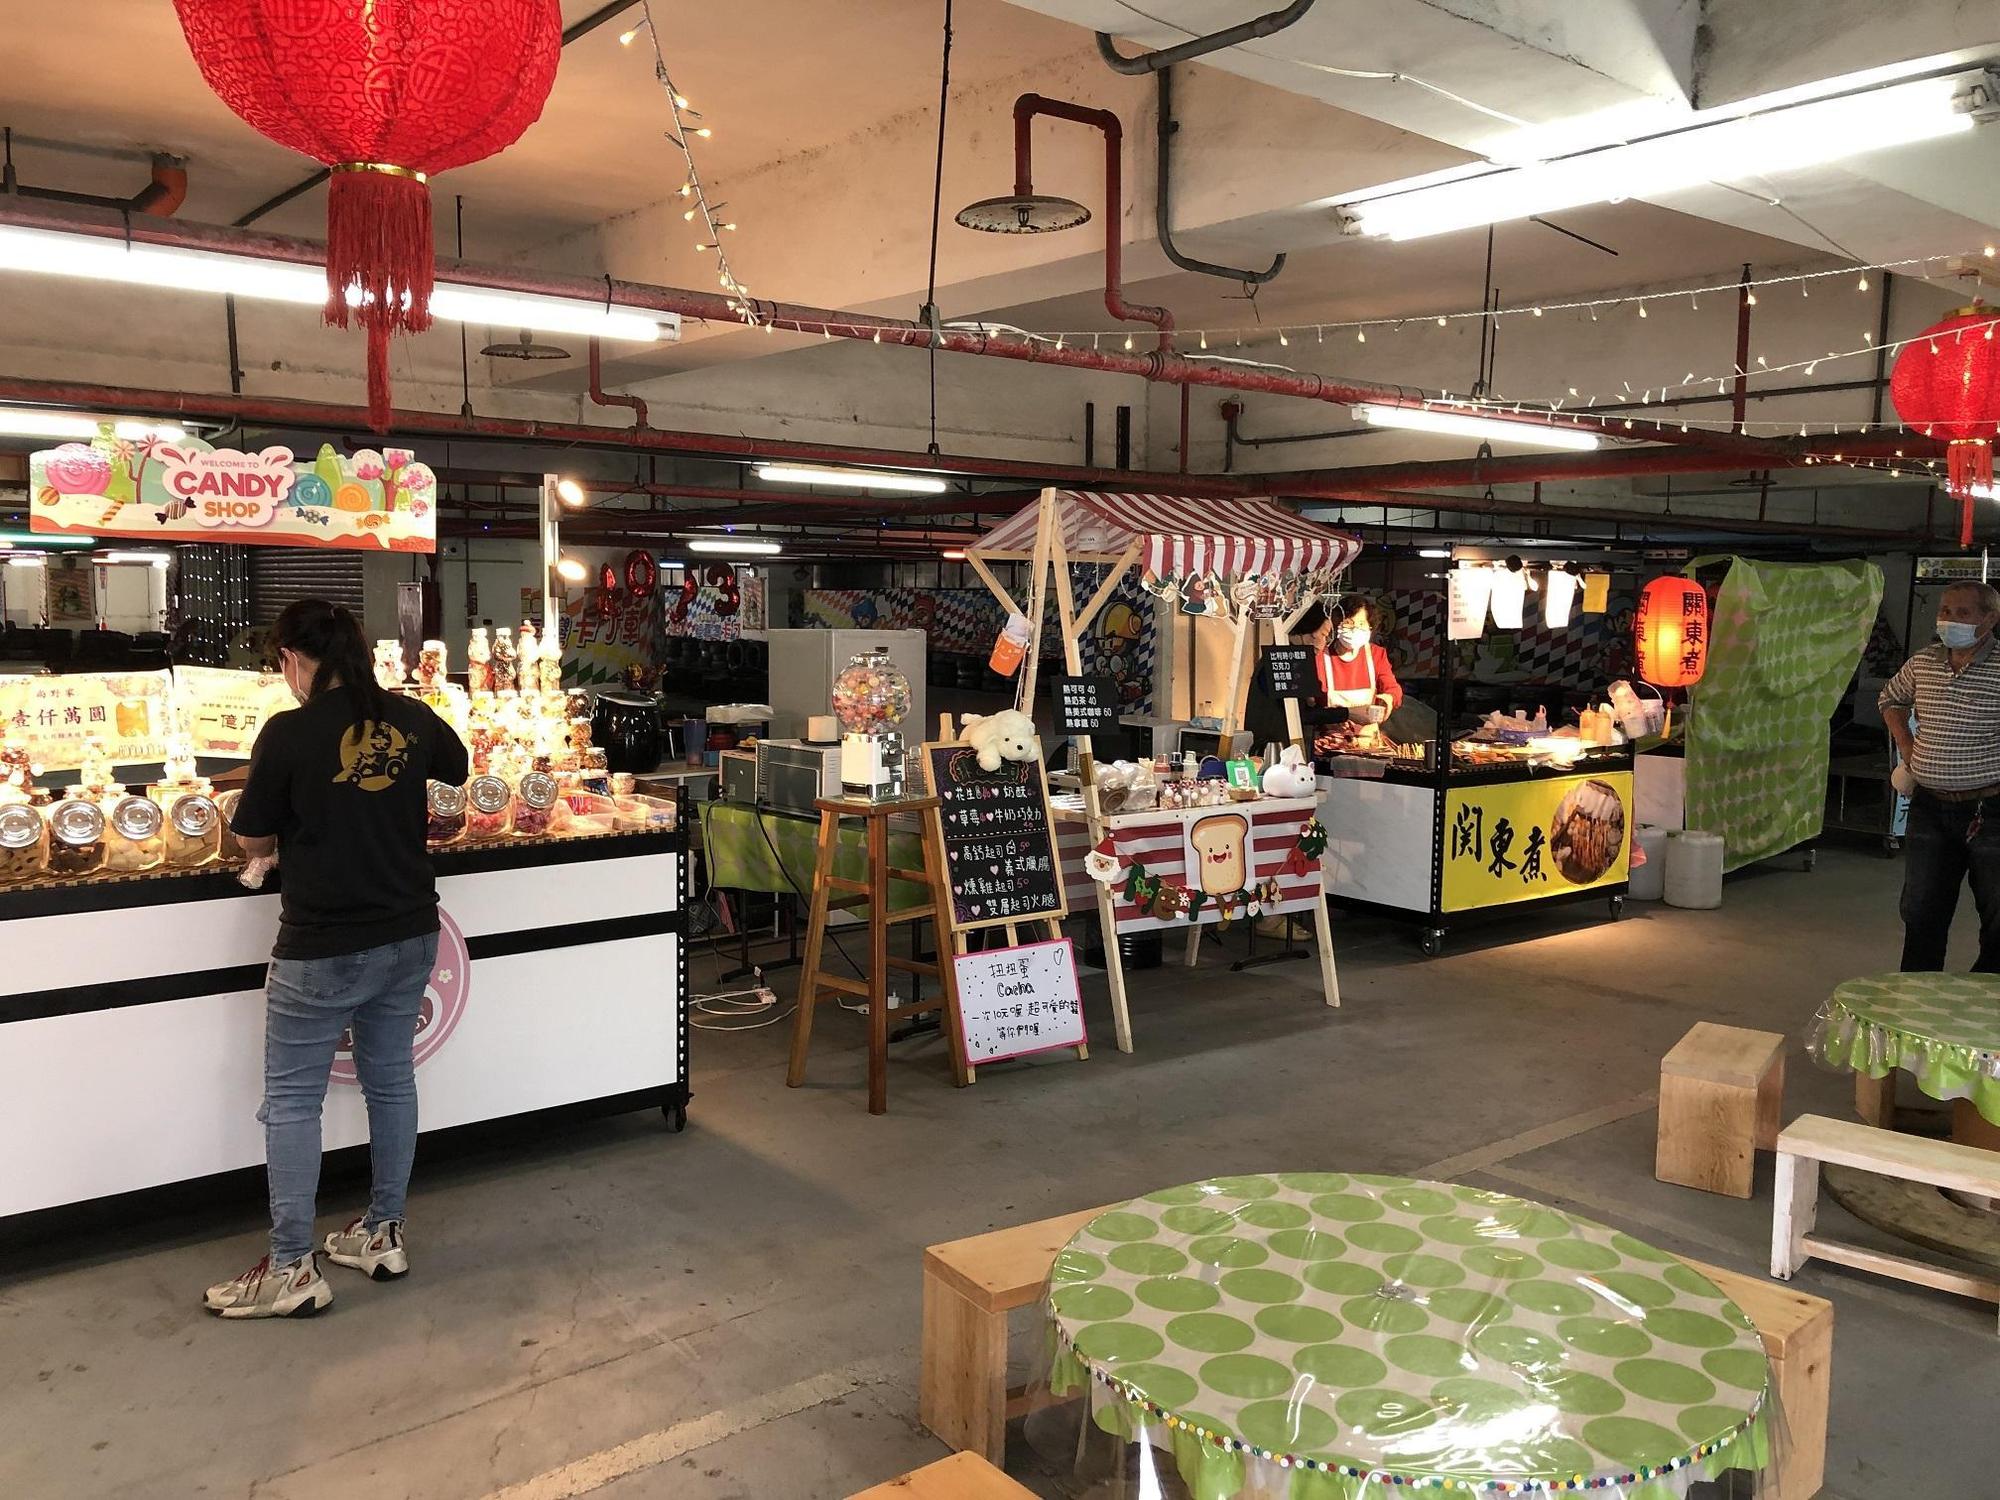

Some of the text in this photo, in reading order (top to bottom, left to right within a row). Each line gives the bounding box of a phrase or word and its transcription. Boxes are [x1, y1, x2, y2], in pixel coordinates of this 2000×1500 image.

[200, 459, 260, 469] WELCOME TO
[173, 471, 284, 498] CANDY
[204, 501, 261, 518] SHOP
[1680, 591, 1706, 676] 關東煮
[1271, 661, 1291, 670] 巧克力
[1273, 671, 1292, 680] 棉花糖
[1063, 684, 1096, 694] 熱可可 40
[1064, 696, 1097, 706] 熱奶茶 40
[11, 705, 106, 728] 壹仟萬圓
[1065, 707, 1112, 717] 熱美式咖啡 60
[199, 714, 257, 730] 一億円
[1066, 718, 1099, 728] 熱拿鐵 60
[955, 786, 976, 801] 花生
[1003, 785, 1028, 799] 奶酥
[959, 808, 981, 827] 草莓
[995, 805, 1042, 823] 牛奶巧克力
[988, 957, 1030, 979] 扭扭蛋
